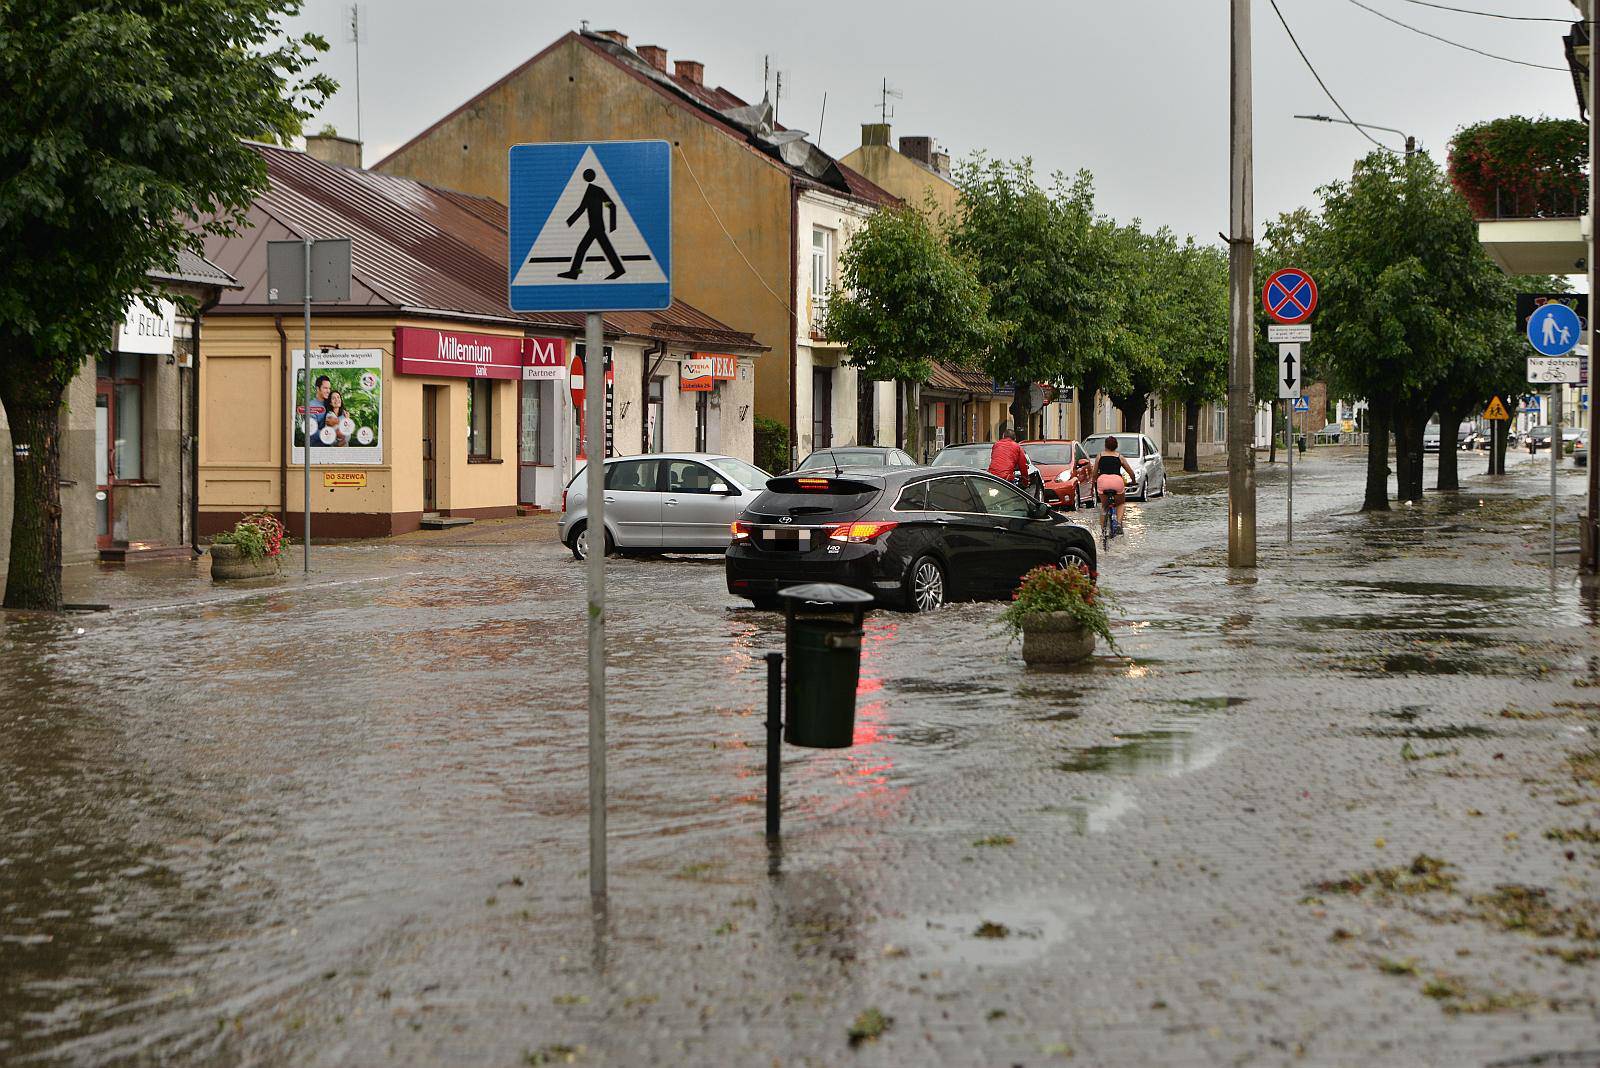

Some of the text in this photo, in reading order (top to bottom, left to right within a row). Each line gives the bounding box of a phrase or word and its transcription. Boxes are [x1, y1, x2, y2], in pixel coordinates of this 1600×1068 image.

[138, 314, 171, 337] BELLA
[437, 331, 492, 363] Millennium
[475, 365, 488, 376] bank
[701, 356, 735, 377] TEKA
[1529, 358, 1578, 368] Nie dotyczy
[528, 369, 556, 378] Partner
